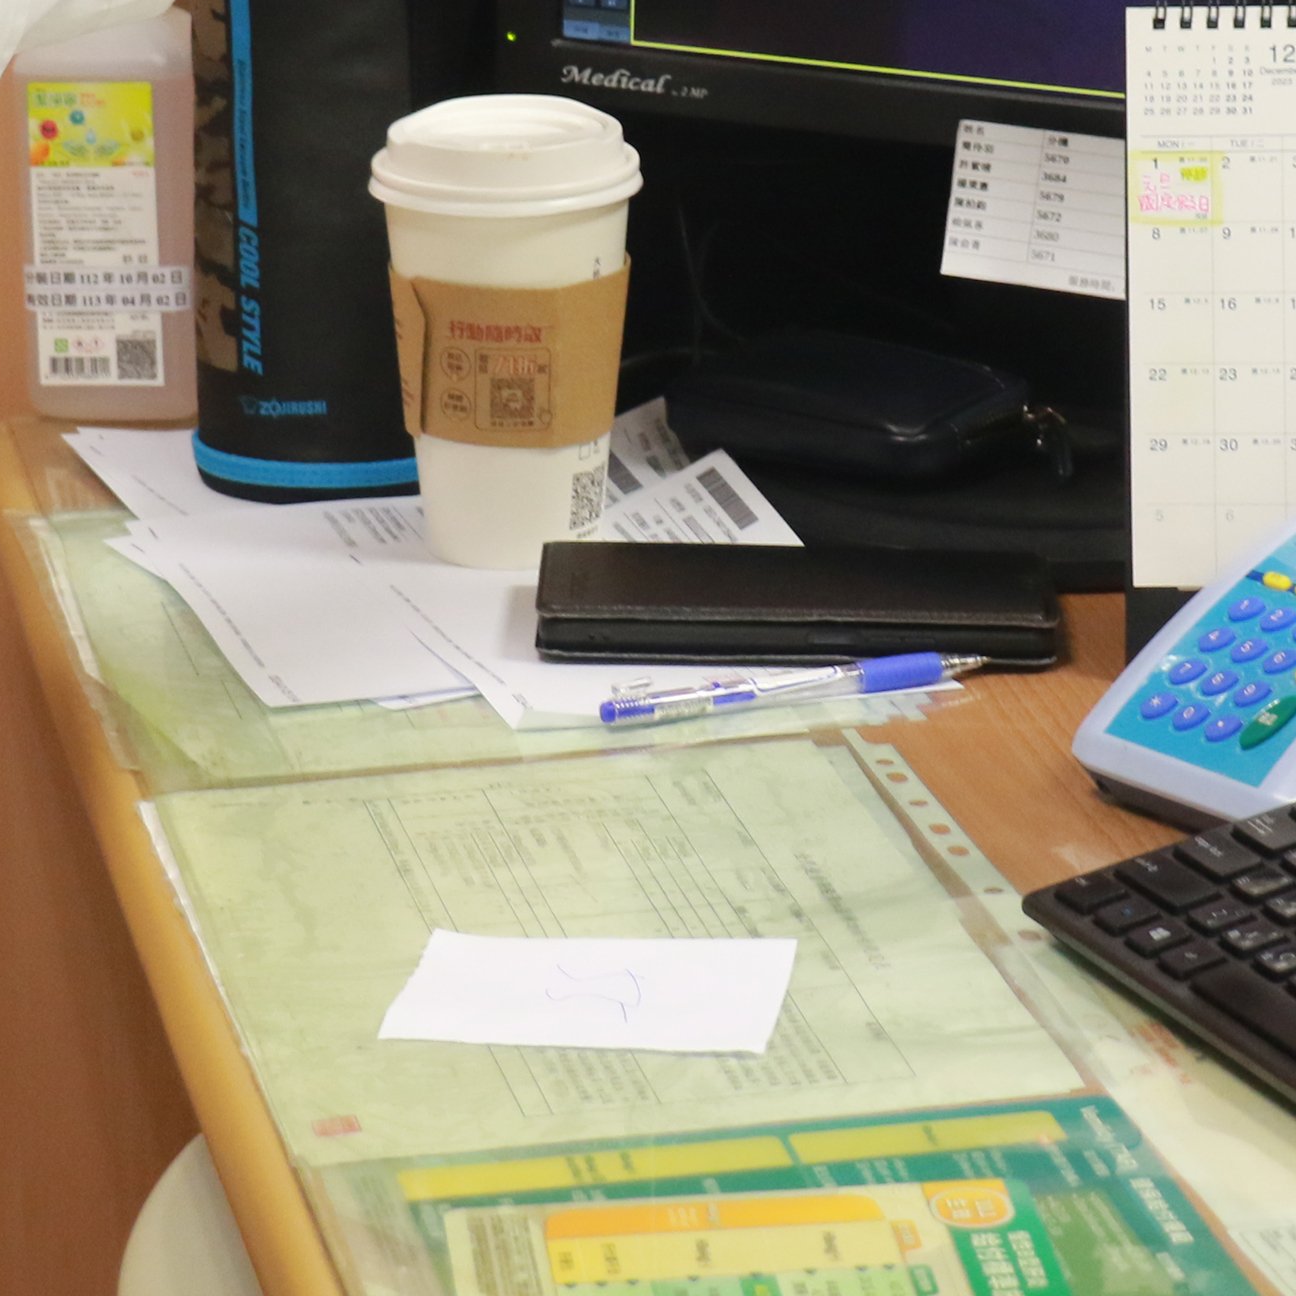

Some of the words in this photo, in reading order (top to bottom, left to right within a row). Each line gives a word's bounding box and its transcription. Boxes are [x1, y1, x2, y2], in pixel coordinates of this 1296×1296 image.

[1269, 44, 1296, 63] 12
[561, 65, 672, 94] Medical
[1222, 157, 1231, 170] 2
[1152, 228, 1161, 240] 8
[1222, 227, 1231, 239] 9
[239, 226, 260, 290] COOL
[104, 272, 115, 285] 年
[137, 271, 149, 285] 月
[171, 270, 183, 284] 日
[106, 293, 117, 307] 年
[140, 292, 152, 307] 月
[175, 291, 187, 306] 日
[1149, 298, 1166, 310] 15
[1220, 298, 1237, 310] 16
[241, 295, 263, 376] STYLE
[1148, 368, 1167, 380] 22
[1219, 368, 1238, 380] 23
[1149, 439, 1168, 452] 29
[1220, 439, 1239, 452] 30
